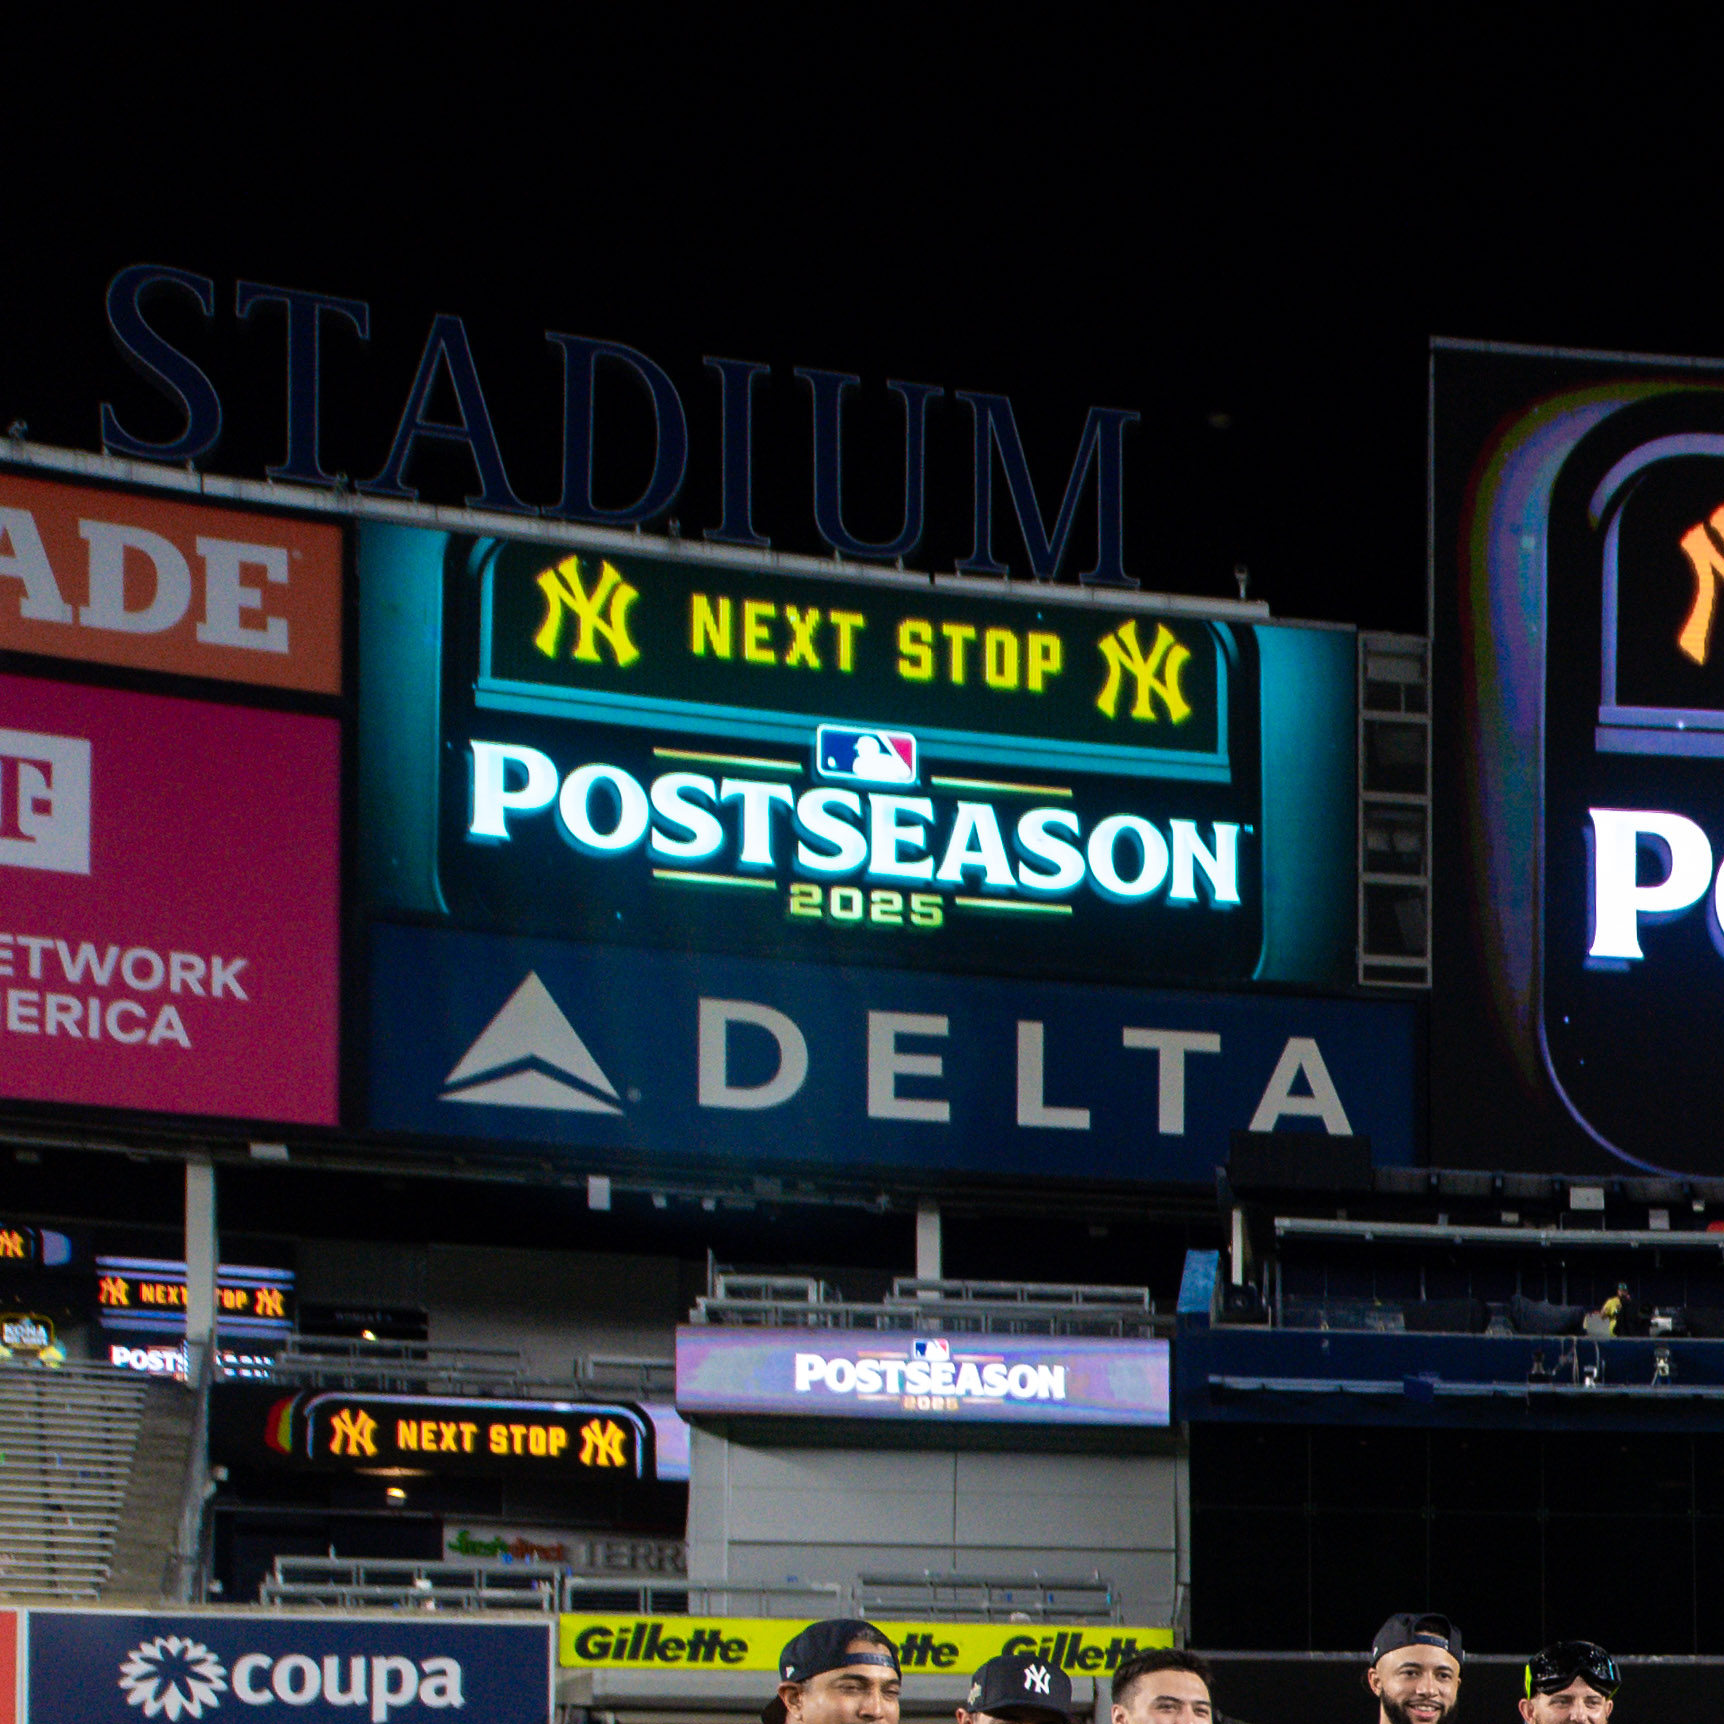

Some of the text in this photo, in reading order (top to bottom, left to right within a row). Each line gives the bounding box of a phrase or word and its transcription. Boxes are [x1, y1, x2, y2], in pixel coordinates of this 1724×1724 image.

[100, 263, 1141, 588] STADIUM
[689, 594, 1063, 693] NEXT STOP
[467, 738, 1241, 906] POSTSEASON
[789, 883, 945, 928] 2025
[697, 997, 1353, 1136] DELTA
[796, 1353, 1065, 1398] POSTSEASON
[397, 1419, 567, 1456] NEXT STOP
[575, 1623, 748, 1663] Gillette
[232, 1652, 465, 1724] coupa
